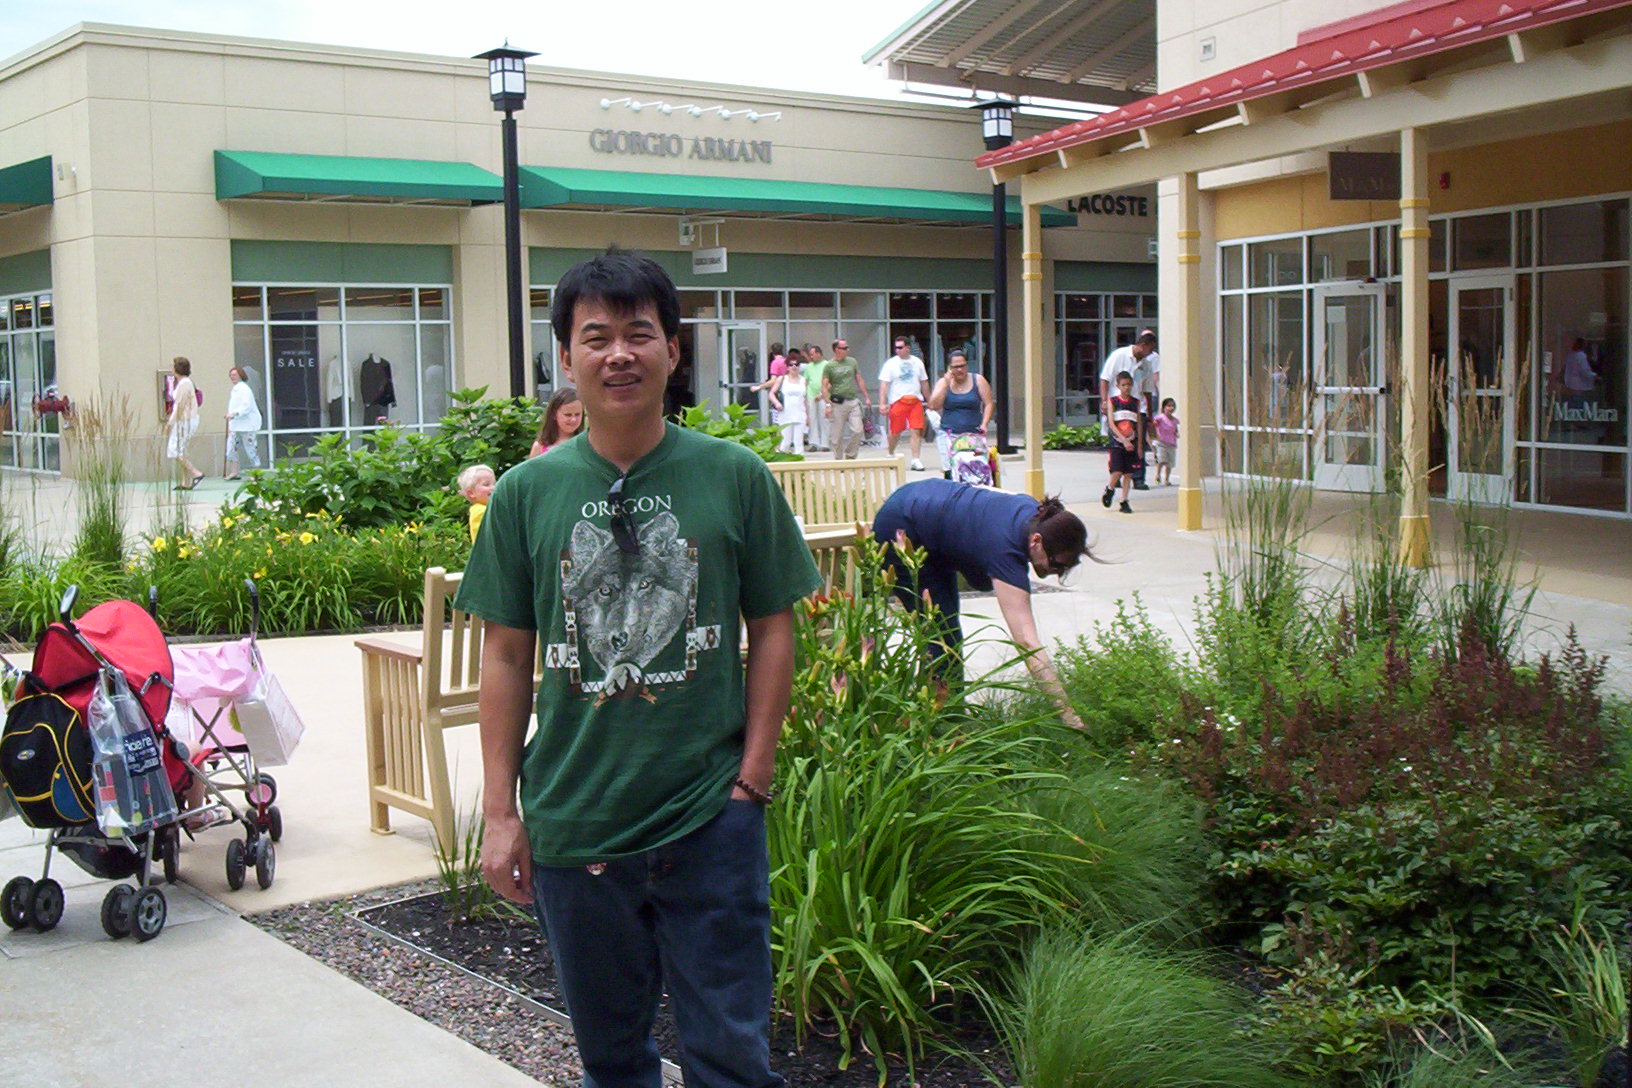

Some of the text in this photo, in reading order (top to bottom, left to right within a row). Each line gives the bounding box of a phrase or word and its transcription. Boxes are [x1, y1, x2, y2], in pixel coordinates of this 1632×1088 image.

[590, 128, 773, 164] GIORGIO ARMANI
[1067, 194, 1147, 216] LACOSTE
[277, 358, 315, 368] SALE
[1554, 401, 1618, 421] MaxMara
